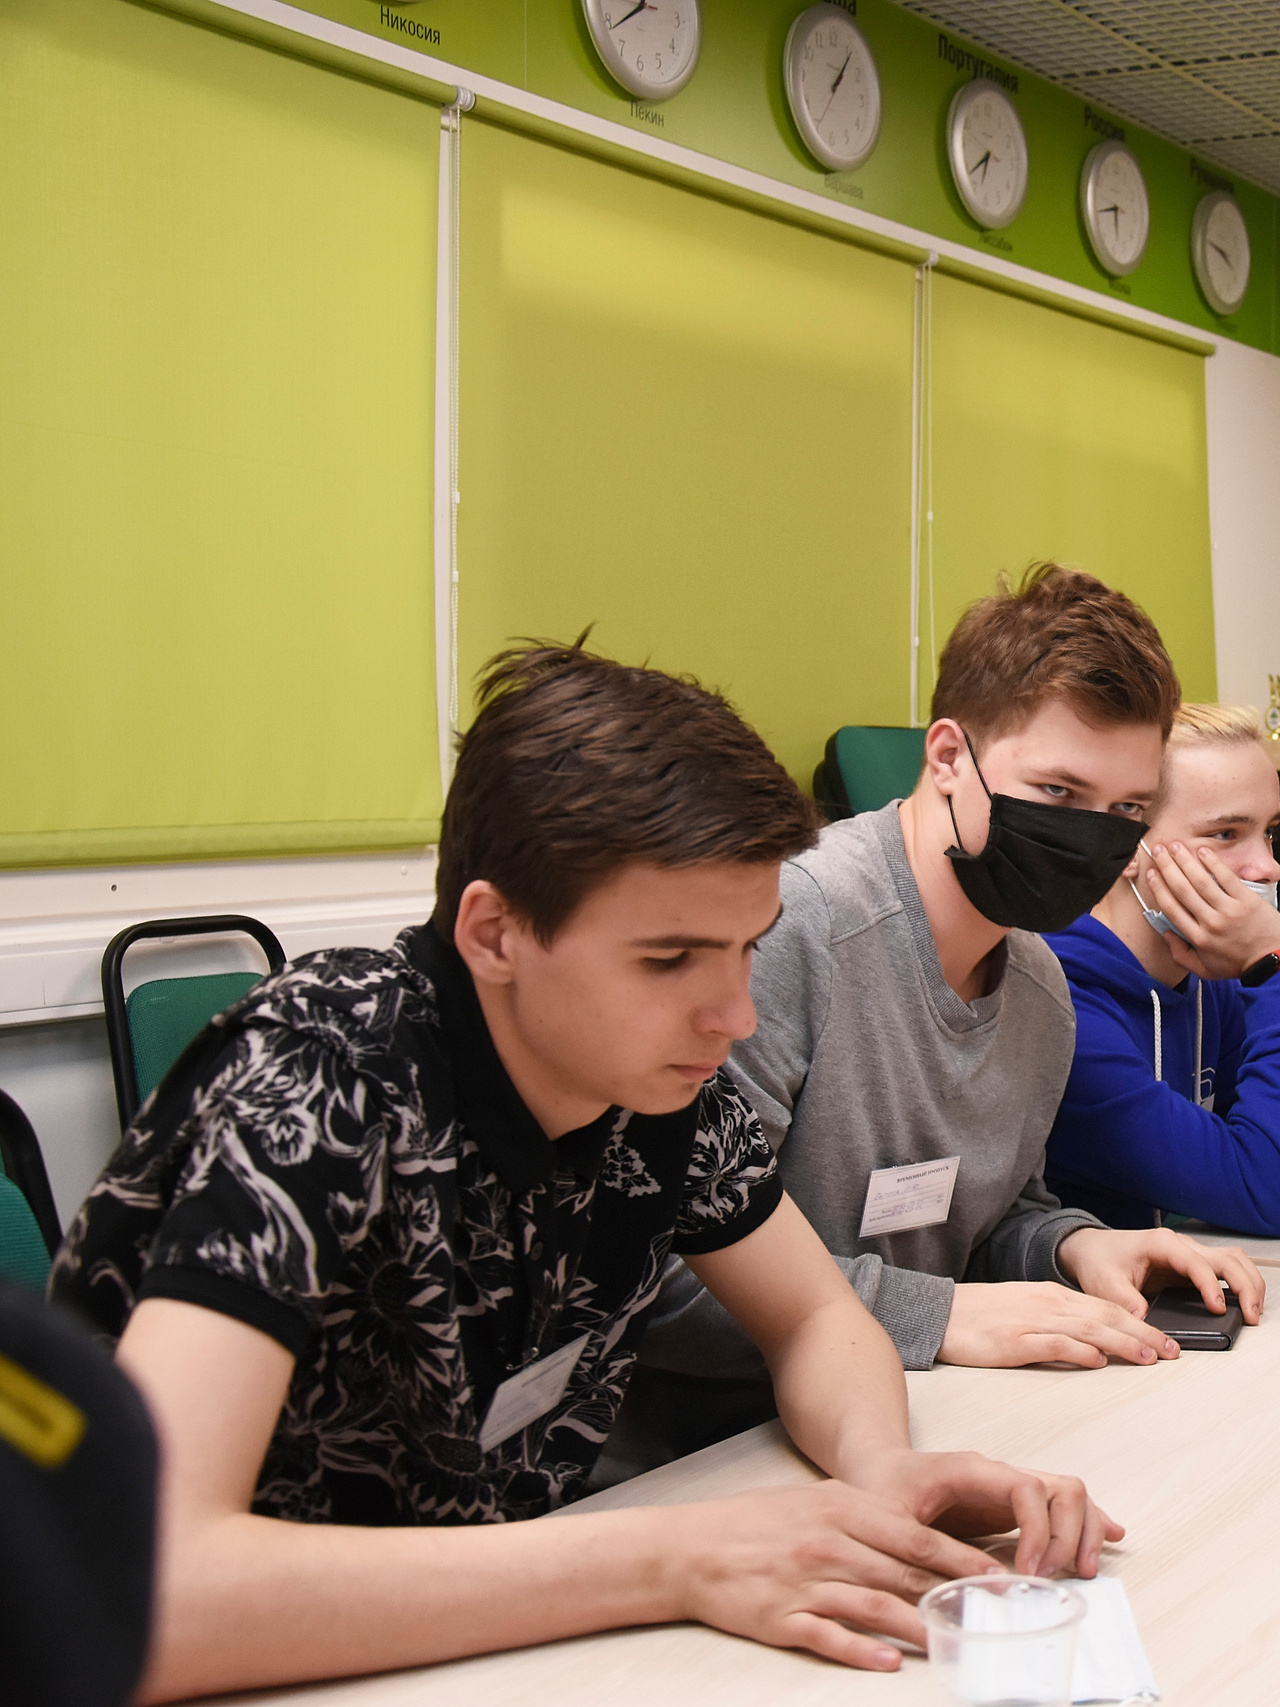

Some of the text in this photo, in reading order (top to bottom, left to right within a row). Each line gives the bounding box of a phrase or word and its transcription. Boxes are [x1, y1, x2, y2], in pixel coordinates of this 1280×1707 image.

[380, 5, 440, 46] Никосия
[604, 12, 613, 30] 8
[674, 11, 681, 28] 3
[619, 38, 626, 57] 7
[669, 38, 675, 53] 4
[636, 54, 644, 72] 6
[655, 52, 662, 70] 5
[938, 33, 1018, 93] Португалия
[630, 100, 665, 127] Пекин
